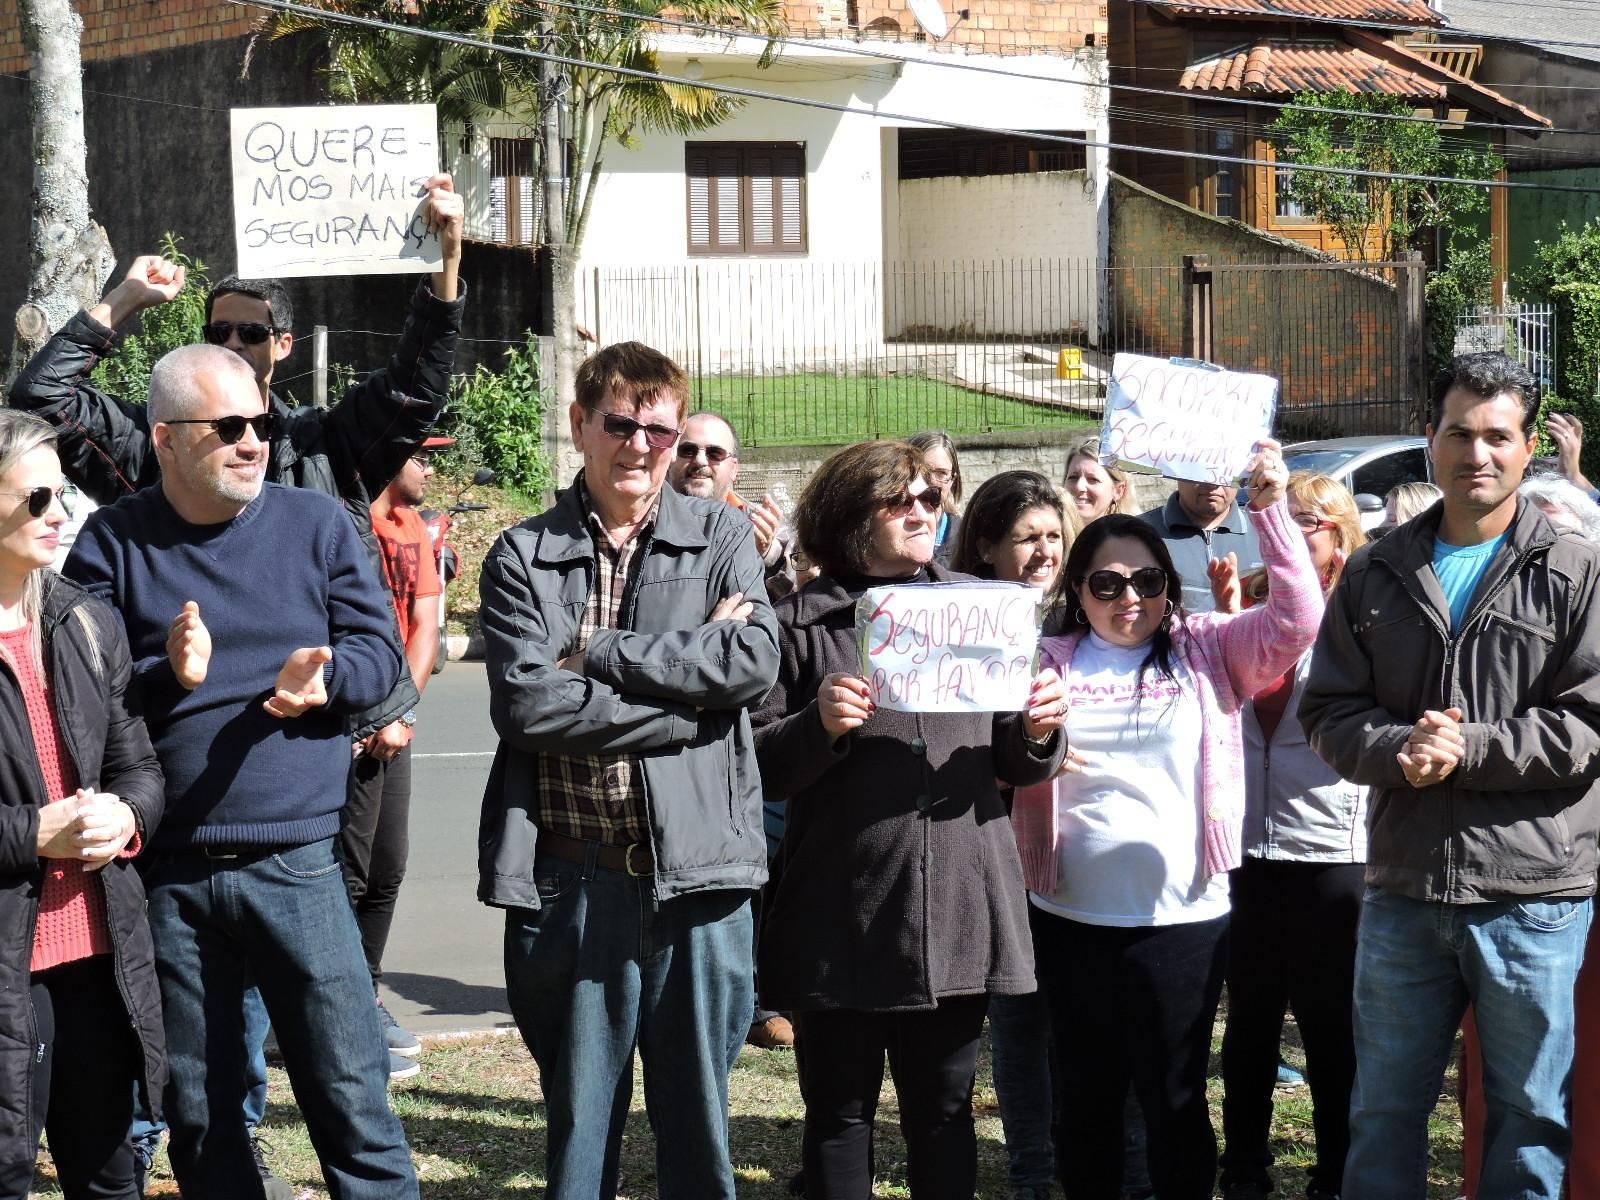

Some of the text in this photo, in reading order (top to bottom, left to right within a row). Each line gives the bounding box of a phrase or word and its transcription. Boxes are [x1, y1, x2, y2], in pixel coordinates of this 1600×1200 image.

[252, 172, 430, 206] MOS MAIS
[871, 667, 921, 704] POR
